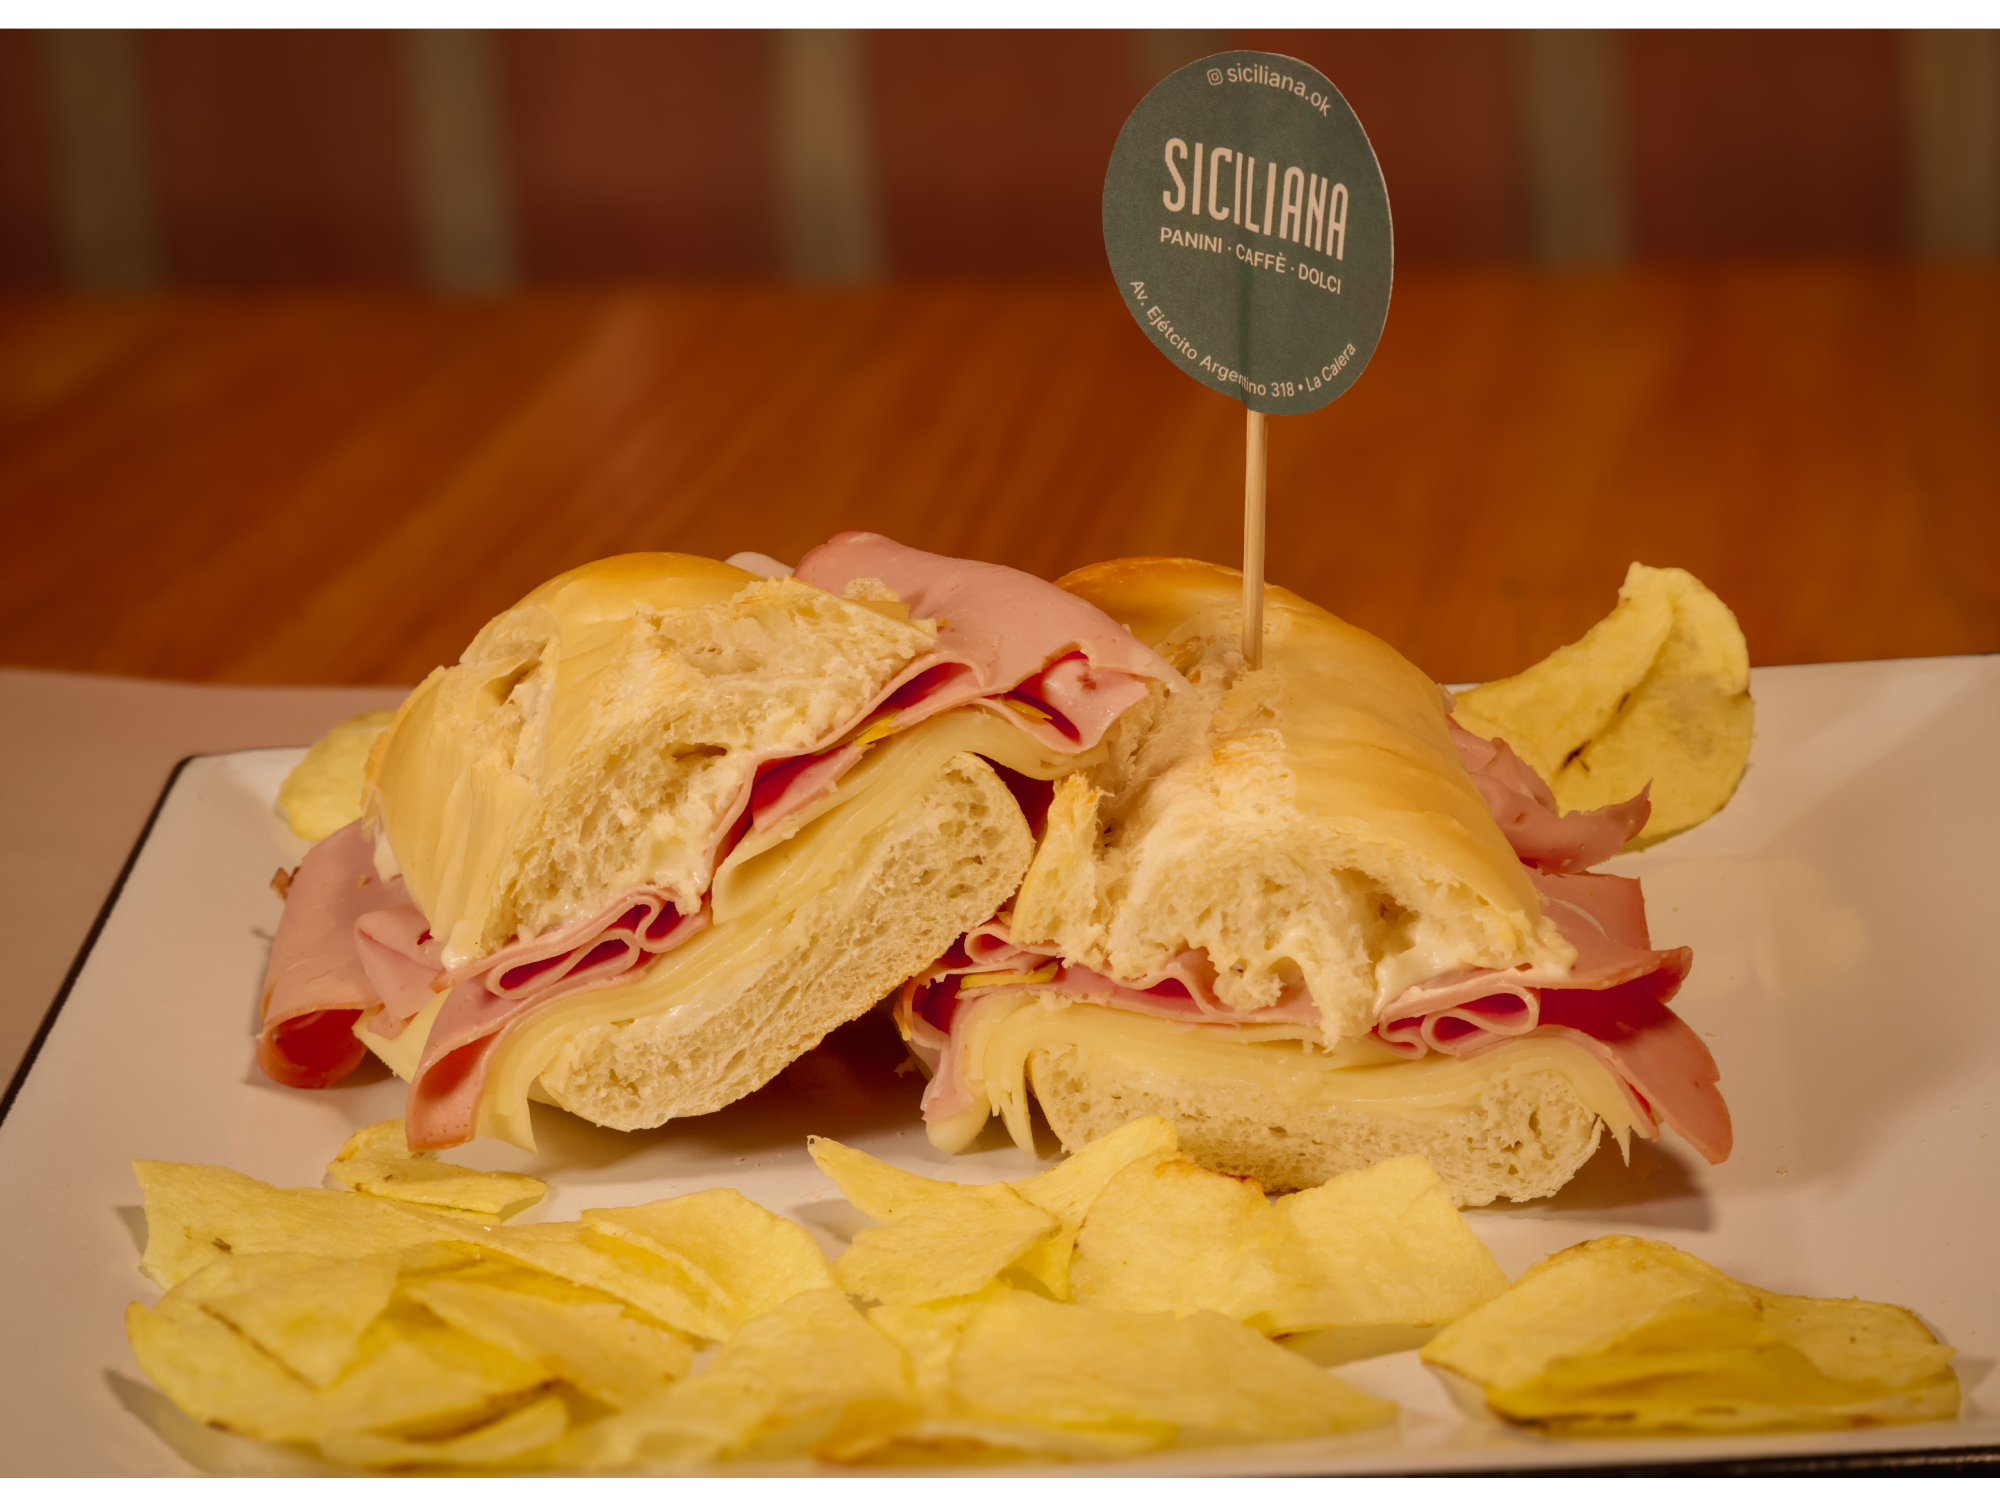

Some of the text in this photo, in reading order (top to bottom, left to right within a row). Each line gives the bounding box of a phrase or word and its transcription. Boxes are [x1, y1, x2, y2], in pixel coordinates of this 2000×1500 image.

[1227, 63, 1331, 117] siciliana.ok
[1162, 137, 1349, 261] SICILIANA
[1160, 227, 1341, 294] PANINI CAFFÈ DOLCI
[1130, 279, 1148, 306] Av.
[1200, 355, 1266, 396] Argentino
[1271, 381, 1295, 397] 318
[1305, 375, 1321, 392] La
[1321, 343, 1356, 381] Calera
